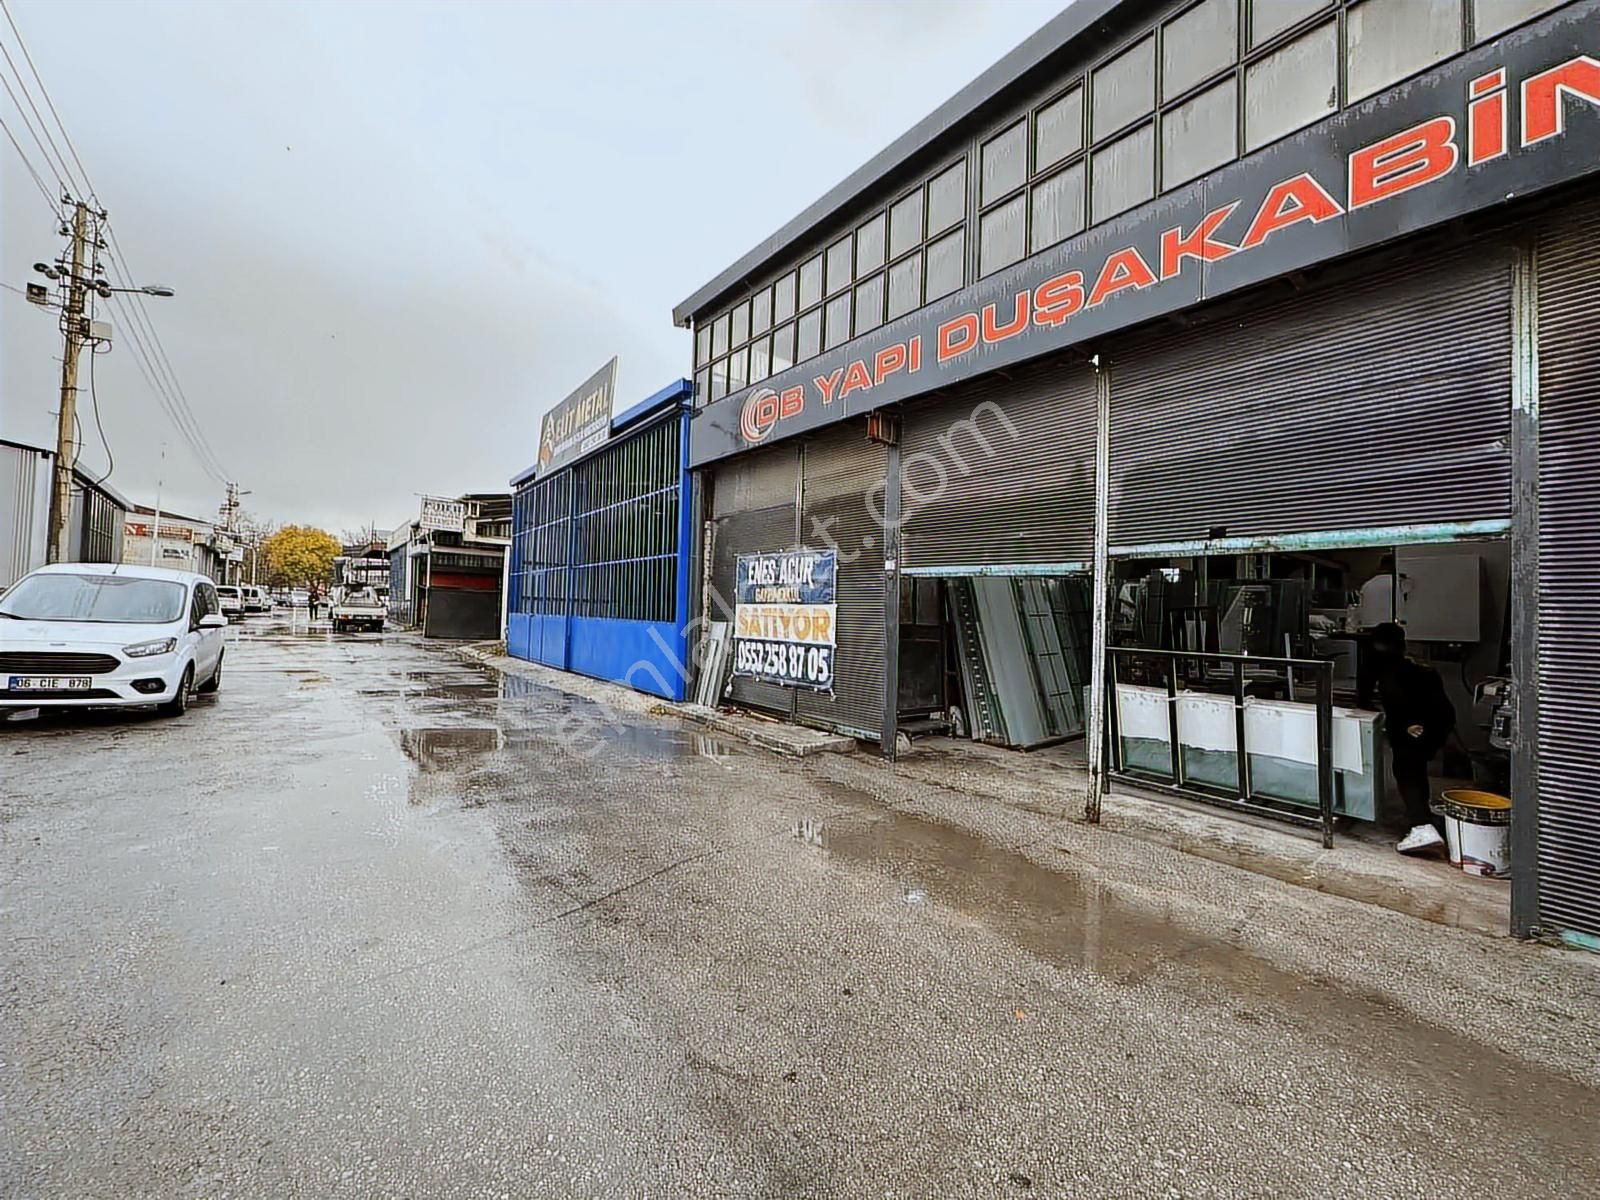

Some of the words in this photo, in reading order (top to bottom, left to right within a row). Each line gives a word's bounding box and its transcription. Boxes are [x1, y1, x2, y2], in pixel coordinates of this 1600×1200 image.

[812, 334, 922, 405] YAPI
[574, 383, 608, 430] METAL
[748, 557, 777, 585] ENES
[737, 607, 831, 642] SATIYOR
[764, 642, 787, 677] 258
[788, 645, 805, 679] 87
[807, 646, 830, 683] 05
[16, 679, 31, 688] 06
[39, 679, 60, 688] CIE
